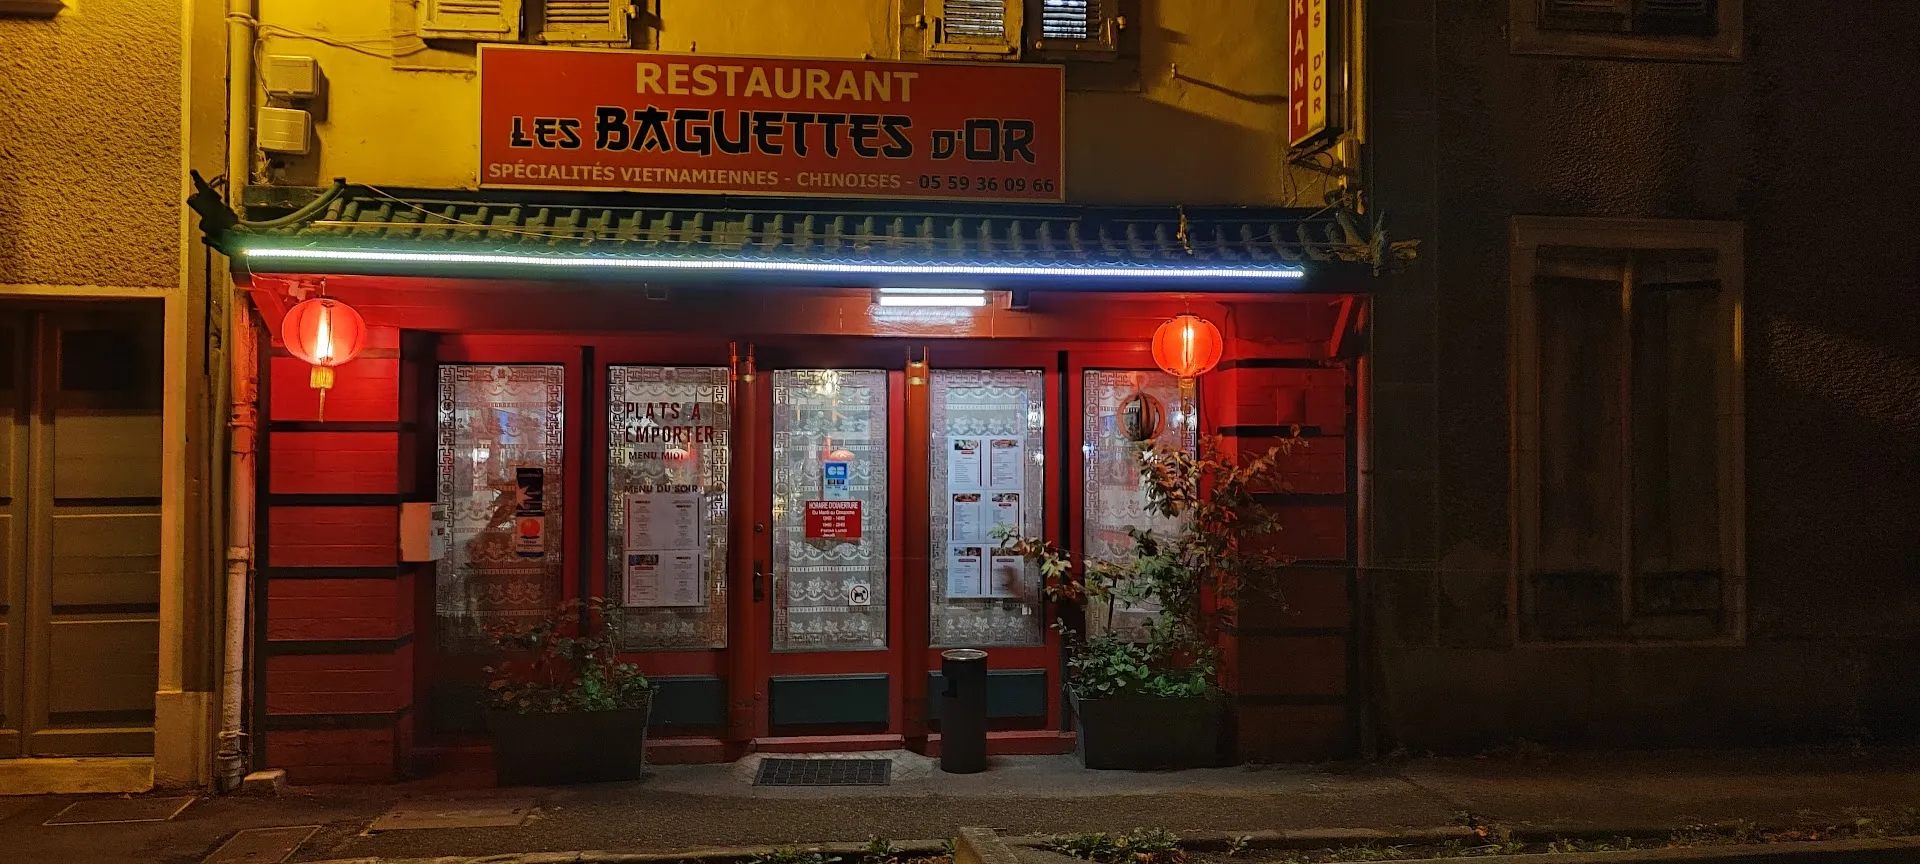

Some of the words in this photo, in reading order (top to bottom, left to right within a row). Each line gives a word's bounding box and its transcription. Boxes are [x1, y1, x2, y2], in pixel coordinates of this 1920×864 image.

[636, 62, 919, 102] RESTAURANT
[509, 115, 582, 149] LES
[594, 104, 914, 159] BAGUETTES
[930, 117, 1037, 164] D'OR
[488, 159, 615, 181] SPÉCIALITÉS
[621, 166, 780, 186] VIETNAMIENNES
[797, 172, 901, 189] CHINOISES
[918, 174, 942, 190] 05
[947, 175, 970, 190] 59
[976, 176, 998, 192] 36
[1004, 177, 1027, 192] 09
[1032, 178, 1055, 193] 66
[625, 402, 680, 420] PLATS
[625, 425, 714, 443] EMPORTER
[628, 452, 657, 460] MENU
[661, 452, 684, 460] MIDI
[624, 485, 653, 493] MENU
[656, 485, 671, 493] DU
[674, 485, 698, 493] SOIR
